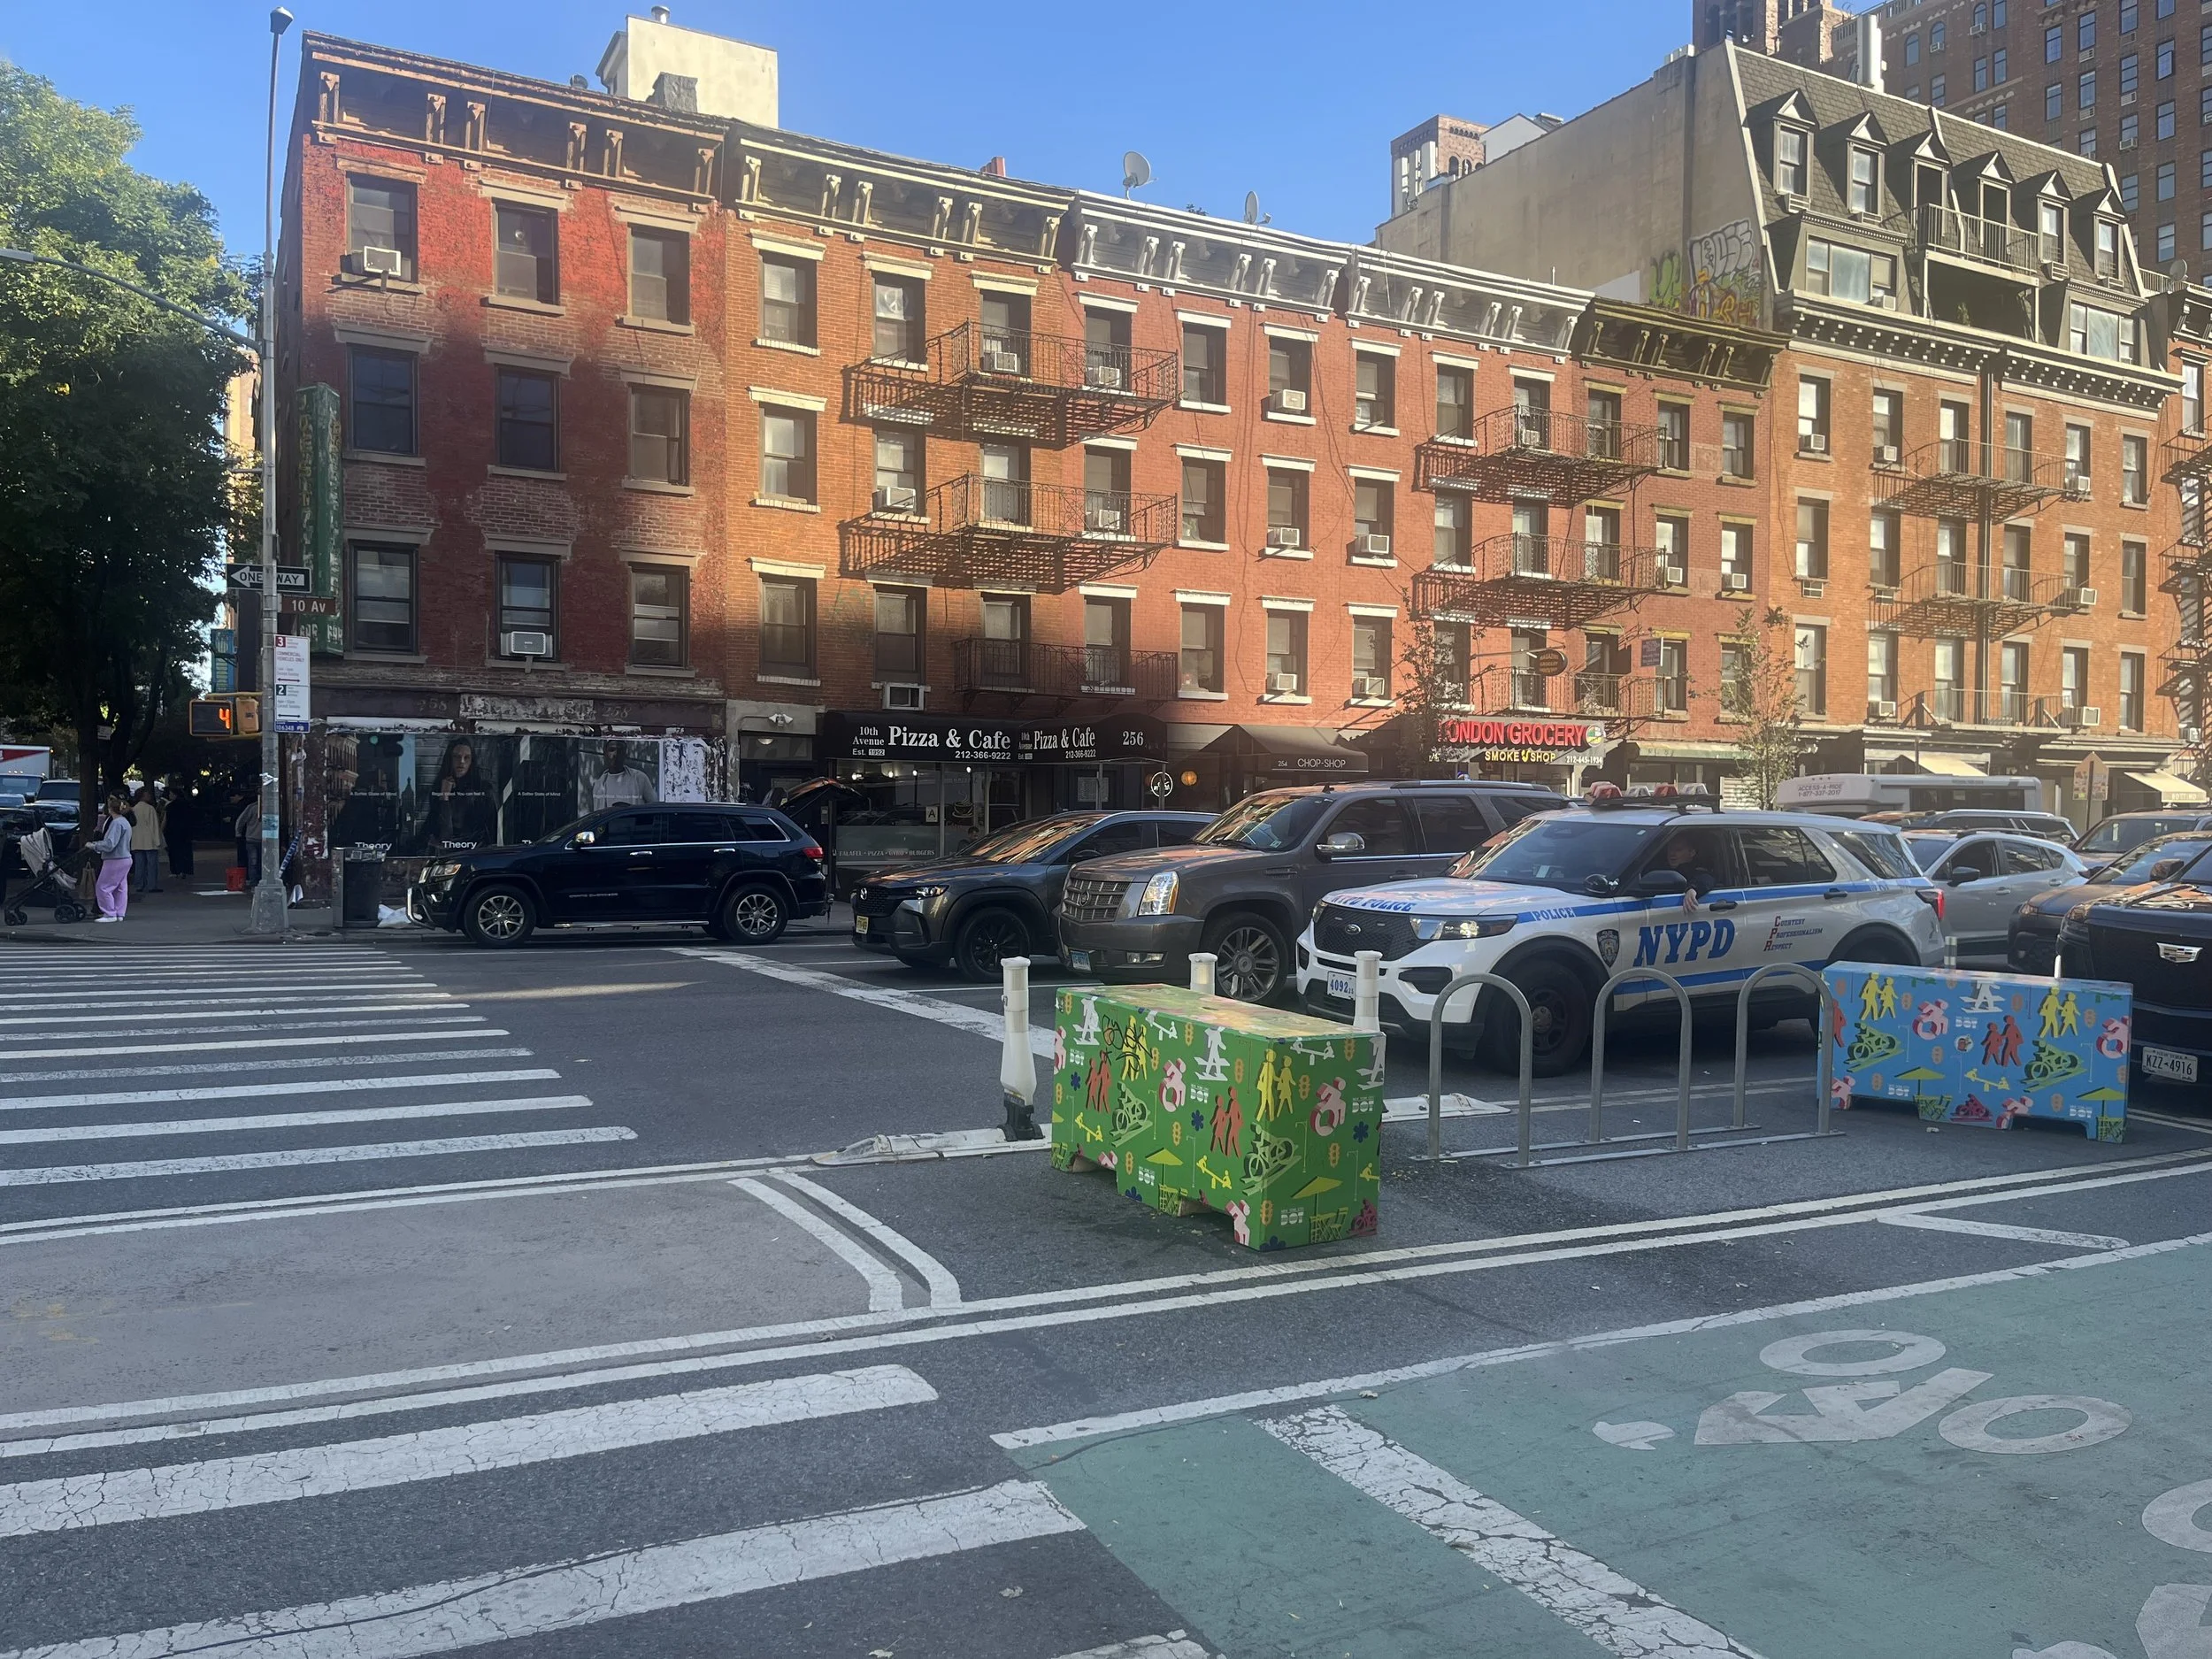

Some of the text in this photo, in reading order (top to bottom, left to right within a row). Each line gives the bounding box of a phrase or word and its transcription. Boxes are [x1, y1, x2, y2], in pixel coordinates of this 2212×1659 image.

[240, 572, 299, 584] ONE WAY
[292, 600, 326, 612] 10 Av
[278, 637, 284, 647] 3
[278, 686, 284, 695] 2
[603, 706, 631, 718] 258
[219, 708, 230, 729] 4
[859, 726, 879, 736] 10th
[1508, 721, 1586, 746] GROCERY
[852, 736, 885, 746] Avenue
[887, 726, 1010, 749] Pizza & Cafe
[1033, 726, 1095, 749] Pizza & Cafe
[1122, 731, 1144, 746] 256
[955, 750, 1011, 760] 212-366-9222
[1065, 749, 1096, 759] 212-366-9222
[1484, 750, 1555, 763] SMOKE SHOP
[1297, 758, 1346, 768] CHOP-SHOP
[928, 809, 936, 818] A
[355, 841, 392, 851] Theory
[442, 841, 478, 849] Theory
[1362, 899, 1416, 912] POLICE
[1533, 906, 1576, 922] POLICE
[1632, 918, 1737, 967] NYPD
[1331, 979, 1348, 994] 4092
[1955, 1018, 1978, 1029] DOT
[1070, 1053, 1085, 1065] DOT
[2146, 1054, 2163, 1070] KZZ
[2170, 1059, 2193, 1076] 4916
[1190, 1088, 1209, 1103] DOT
[1888, 1086, 1909, 1097] DOT
[1352, 1101, 1374, 1113] DOT
[2070, 1107, 2092, 1118] DOT
[1138, 1170, 1155, 1187] DOT
[1281, 1212, 1304, 1225] DOT
